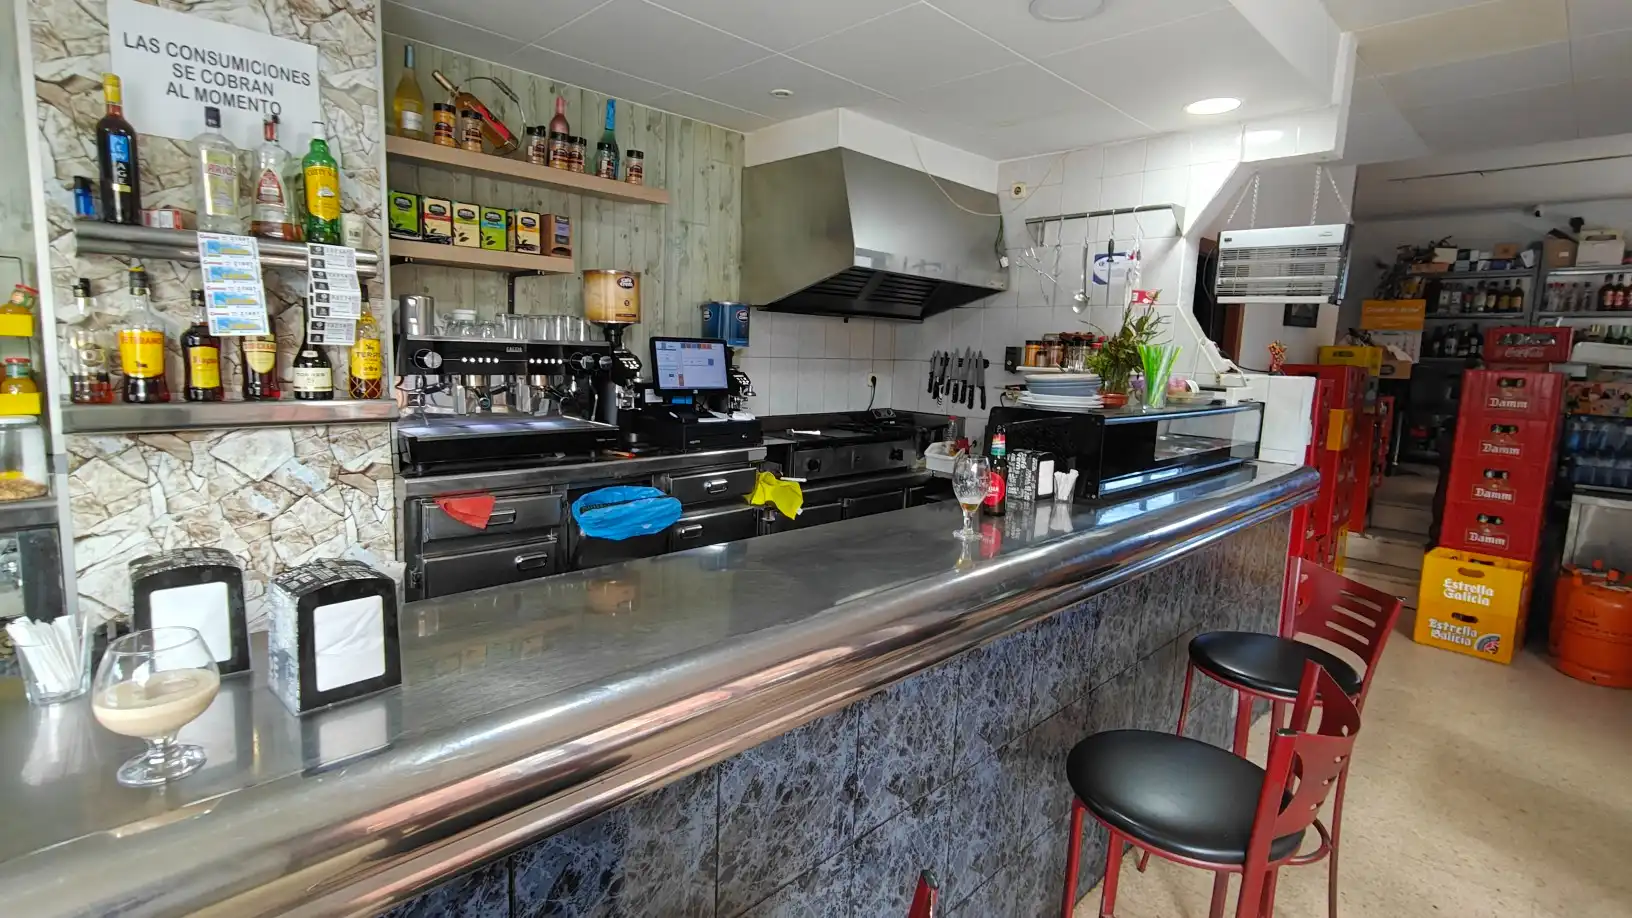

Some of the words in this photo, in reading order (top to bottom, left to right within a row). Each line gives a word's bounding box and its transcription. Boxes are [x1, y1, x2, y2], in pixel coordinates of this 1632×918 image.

[123, 31, 161, 54] LAS
[165, 42, 311, 87] CONSUMICIONES
[172, 62, 196, 81] SE
[200, 69, 274, 97] COBRAN
[166, 81, 190, 98] AL
[194, 86, 282, 116] MOMENTO
[1489, 397, 1528, 409] Damm
[1481, 443, 1520, 455] Damm
[1475, 487, 1512, 501] Damm
[1469, 531, 1506, 545] Damm
[1443, 578, 1495, 597] Estrella
[1443, 588, 1490, 607] Galicia
[1428, 618, 1478, 638] Estrella
[1431, 629, 1472, 647] Galicia
